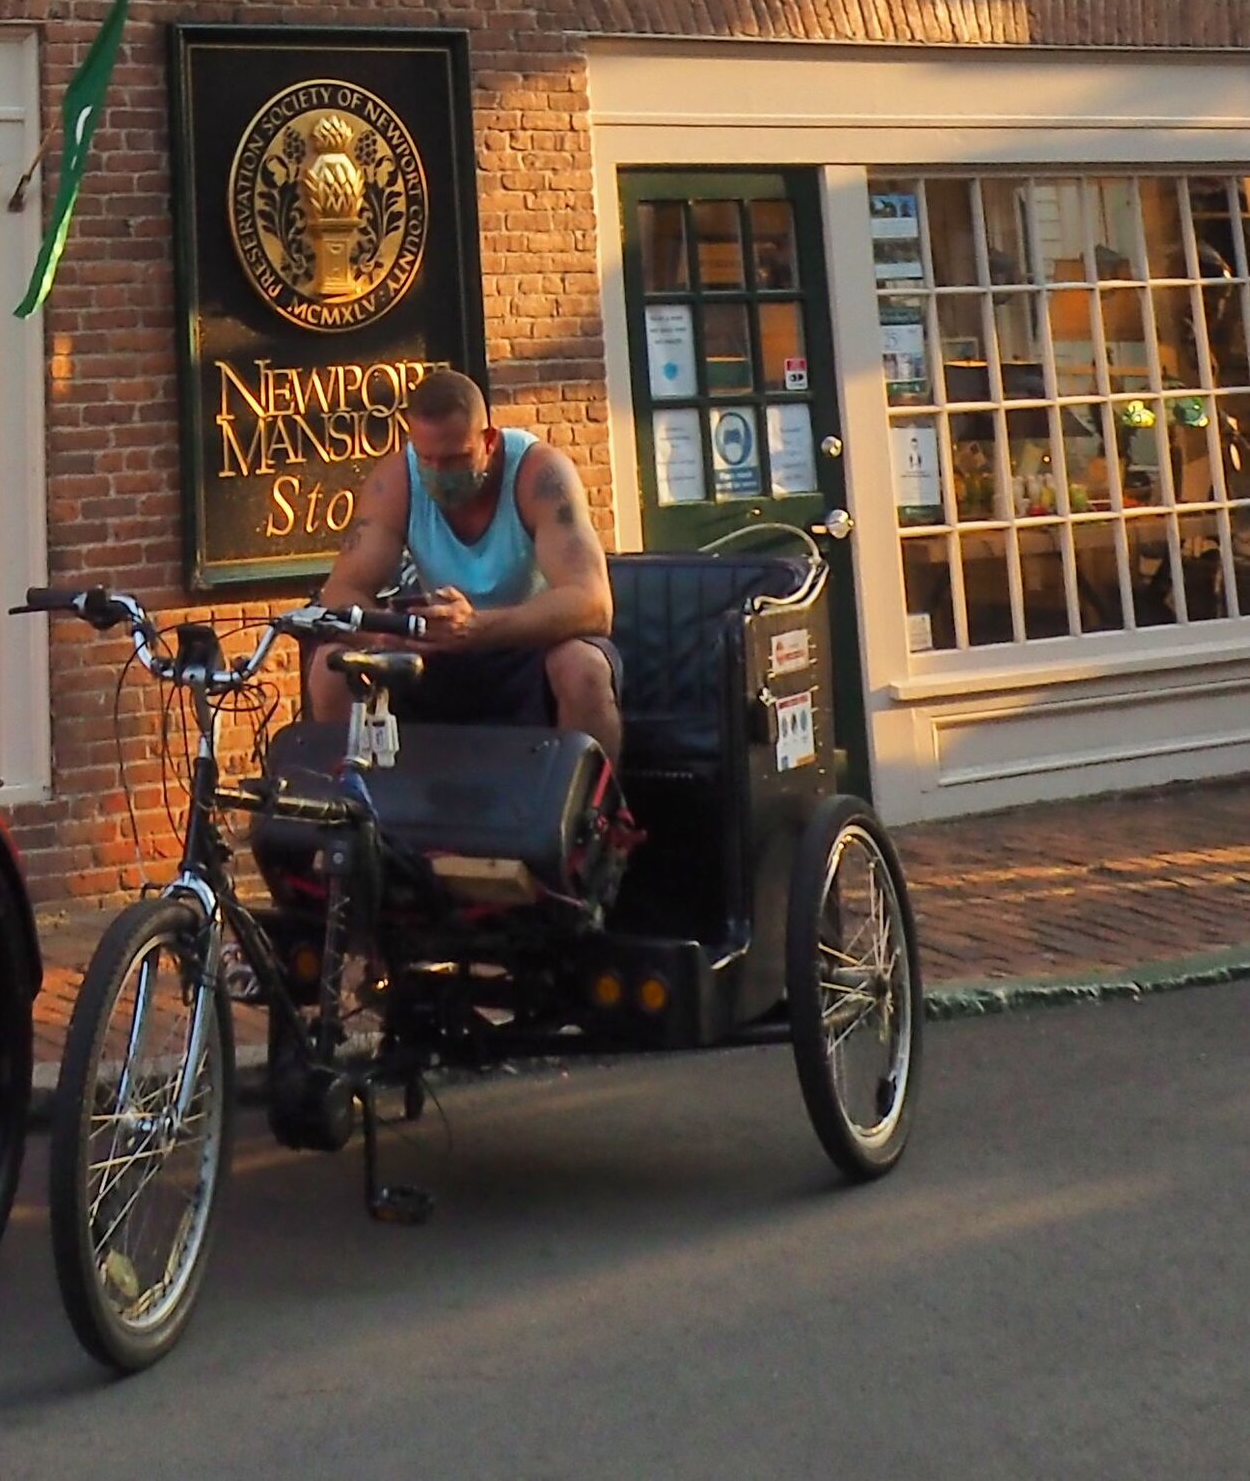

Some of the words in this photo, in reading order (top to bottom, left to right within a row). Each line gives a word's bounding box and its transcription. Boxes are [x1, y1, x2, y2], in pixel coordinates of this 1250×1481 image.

[261, 87, 332, 134] SOCIETY
[337, 88, 364, 110] OF
[363, 100, 423, 198] NEWPORT
[236, 136, 283, 298] PRESERVATION
[386, 205, 423, 297] COUNTY
[265, 474, 356, 537] Sto
